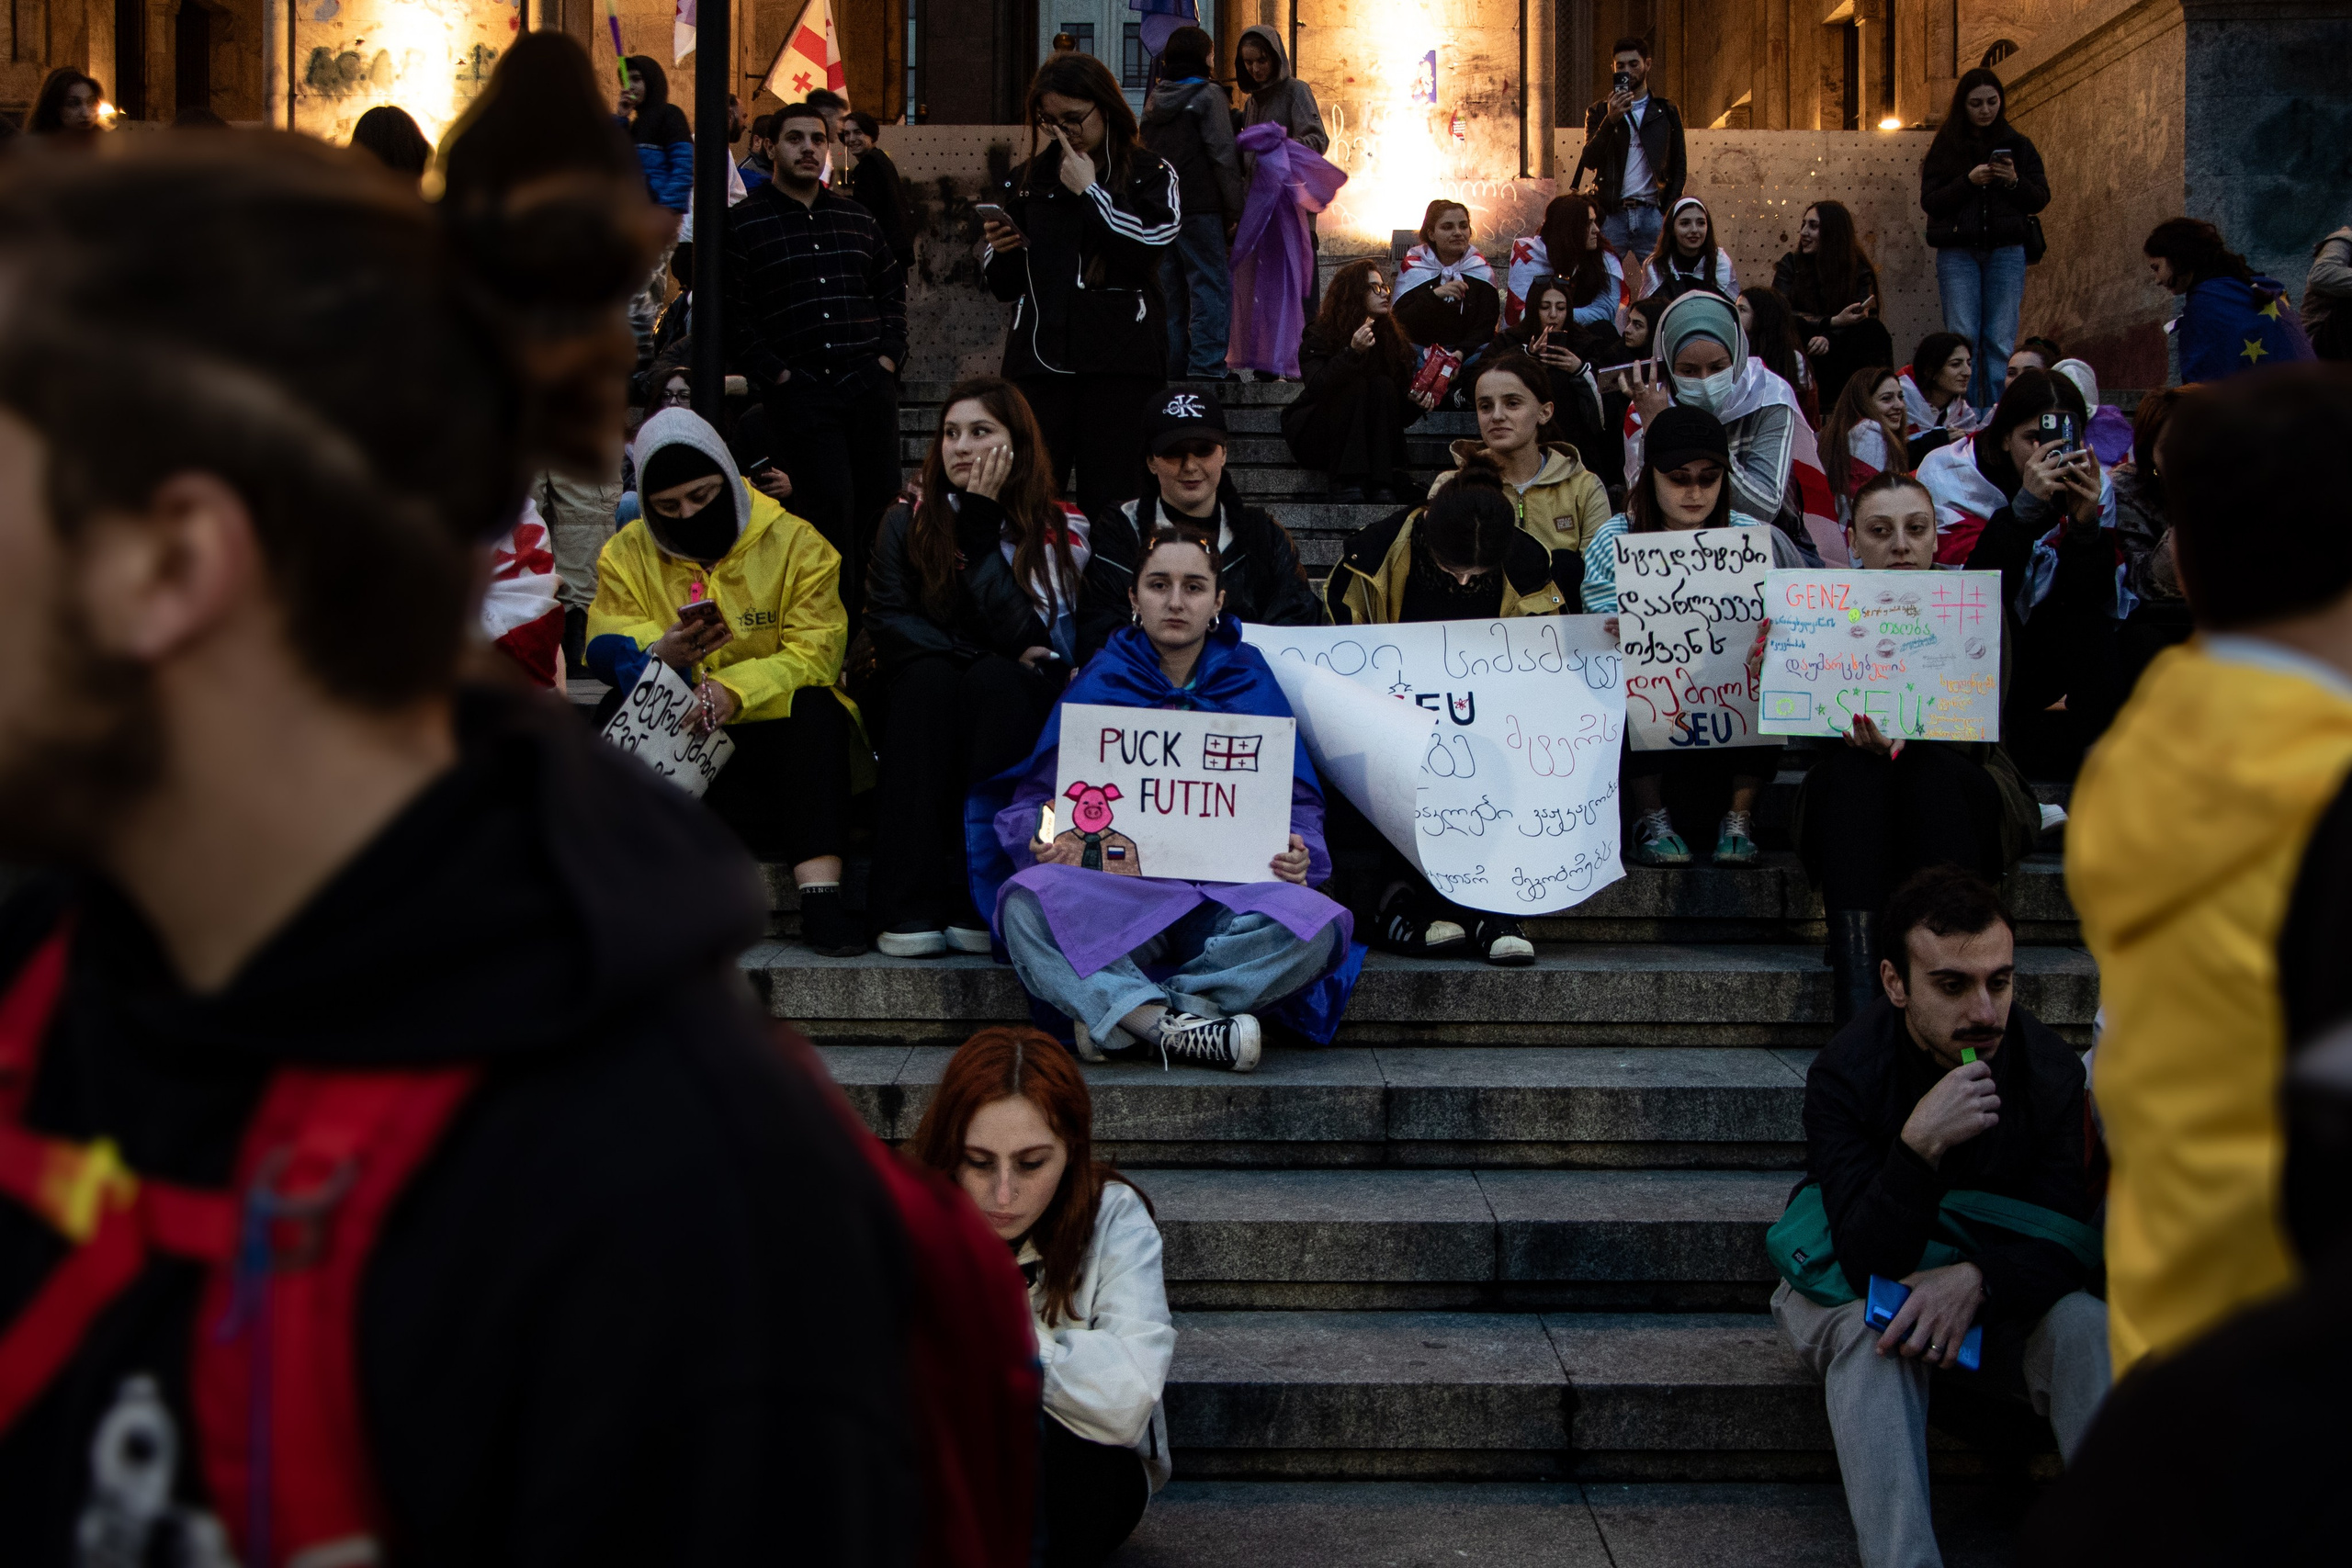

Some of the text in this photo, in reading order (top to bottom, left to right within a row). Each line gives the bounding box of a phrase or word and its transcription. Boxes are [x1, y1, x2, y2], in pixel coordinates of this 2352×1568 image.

[1614, 531, 1767, 576] სტუდენტები
[744, 611, 776, 626] SEU
[1879, 617, 1930, 635] თაობა
[1624, 628, 1726, 665] თქვენს
[1394, 692, 1476, 726] EU
[1827, 689, 1922, 735] SEU
[1100, 728, 1182, 767] PUCK
[1507, 714, 1617, 777] მტერს
[1668, 711, 1733, 747] SEU
[1140, 778, 1237, 818] FUTIN
